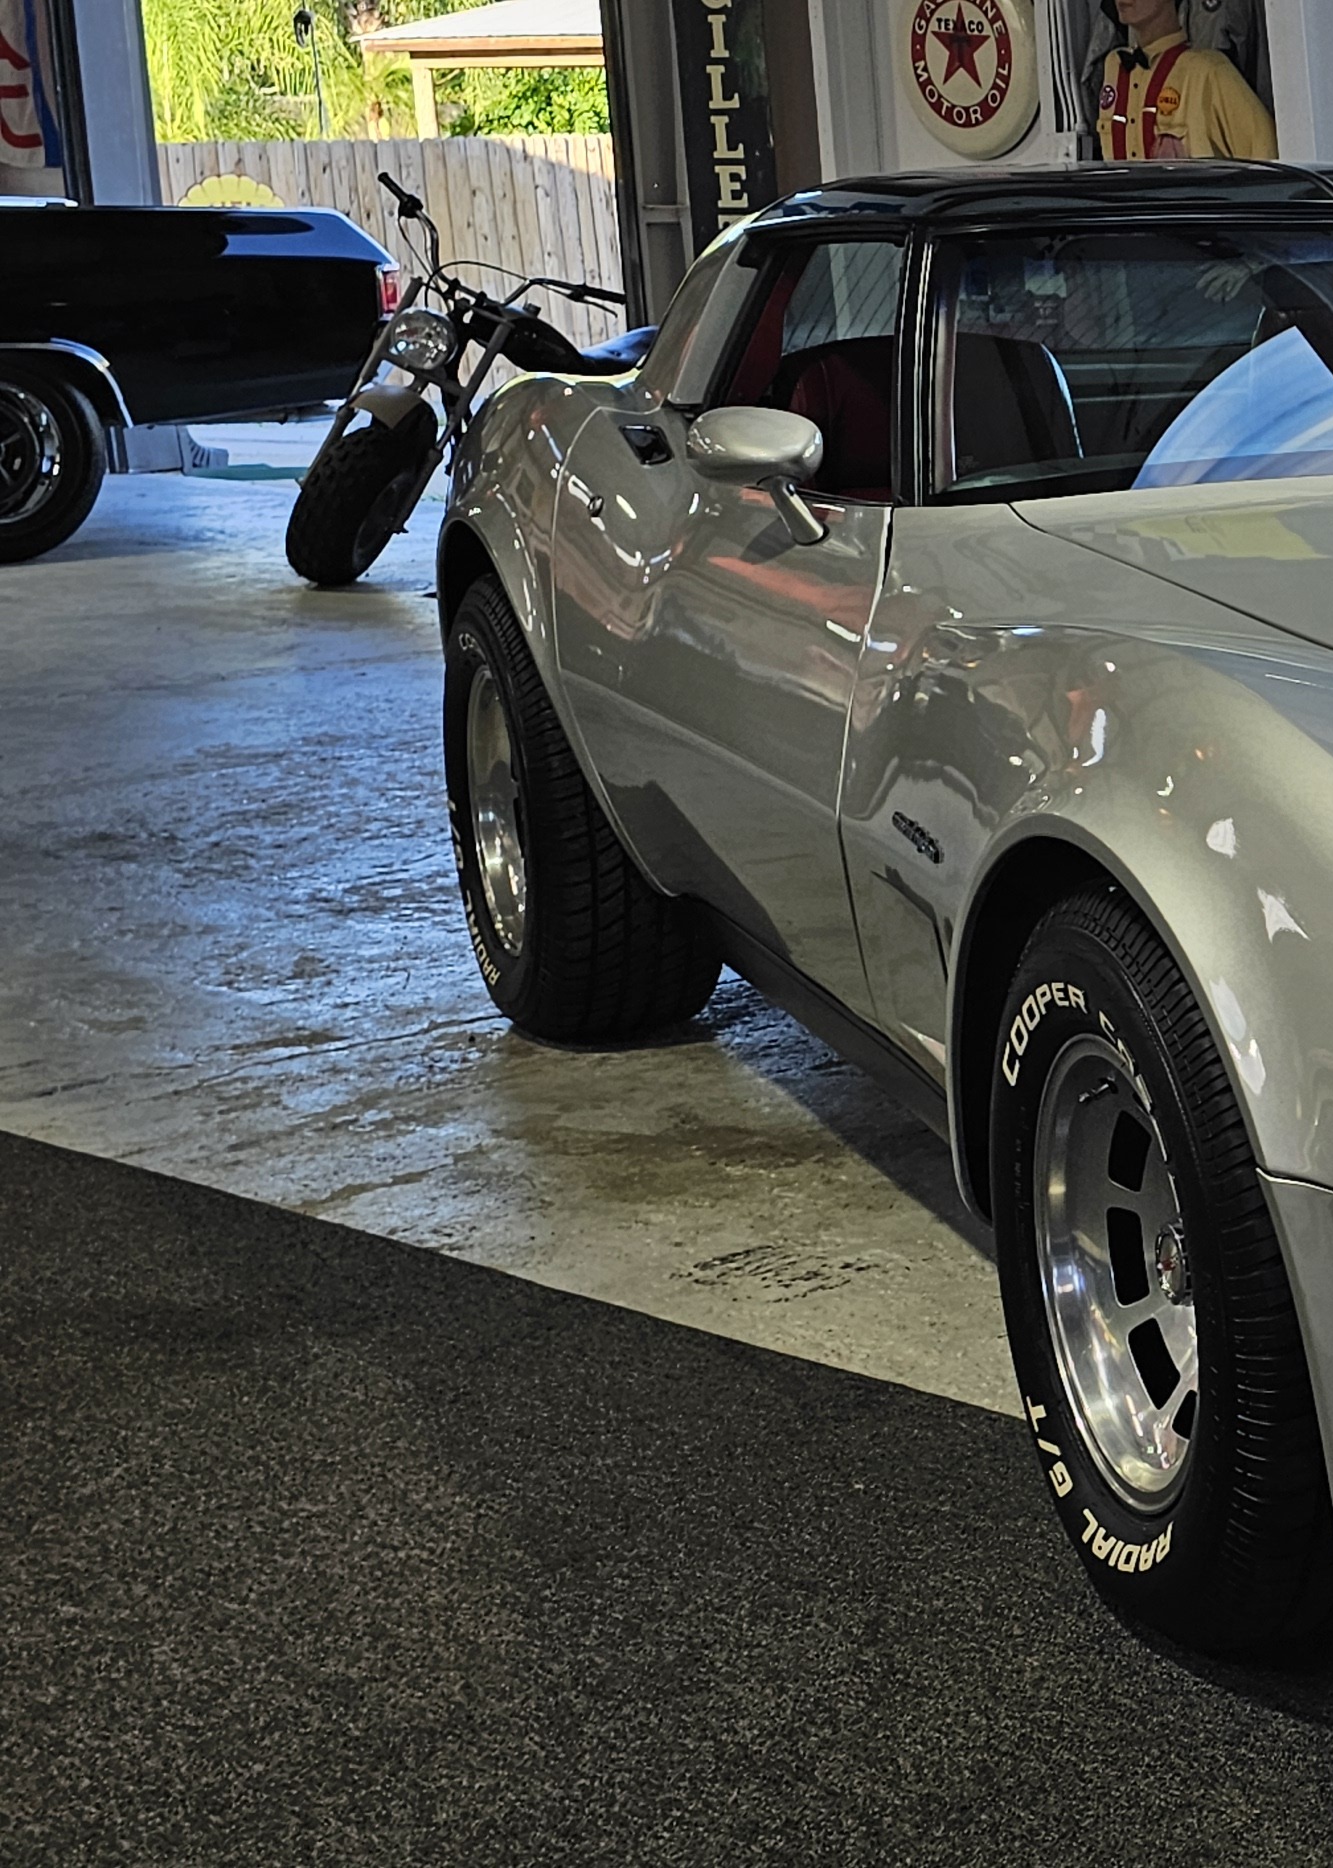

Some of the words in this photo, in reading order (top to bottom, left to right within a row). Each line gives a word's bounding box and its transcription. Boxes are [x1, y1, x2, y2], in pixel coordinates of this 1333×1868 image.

[914, 0, 1006, 38] GANE
[936, 17, 985, 34] TEXCO
[702, 0, 749, 230] ILLE
[914, 60, 983, 124] MOTOR
[987, 63, 1009, 107] OIL
[1002, 976, 1088, 1087] COOPER
[1026, 1395, 1074, 1498] G/T
[1081, 1507, 1174, 1573] RADIAL
